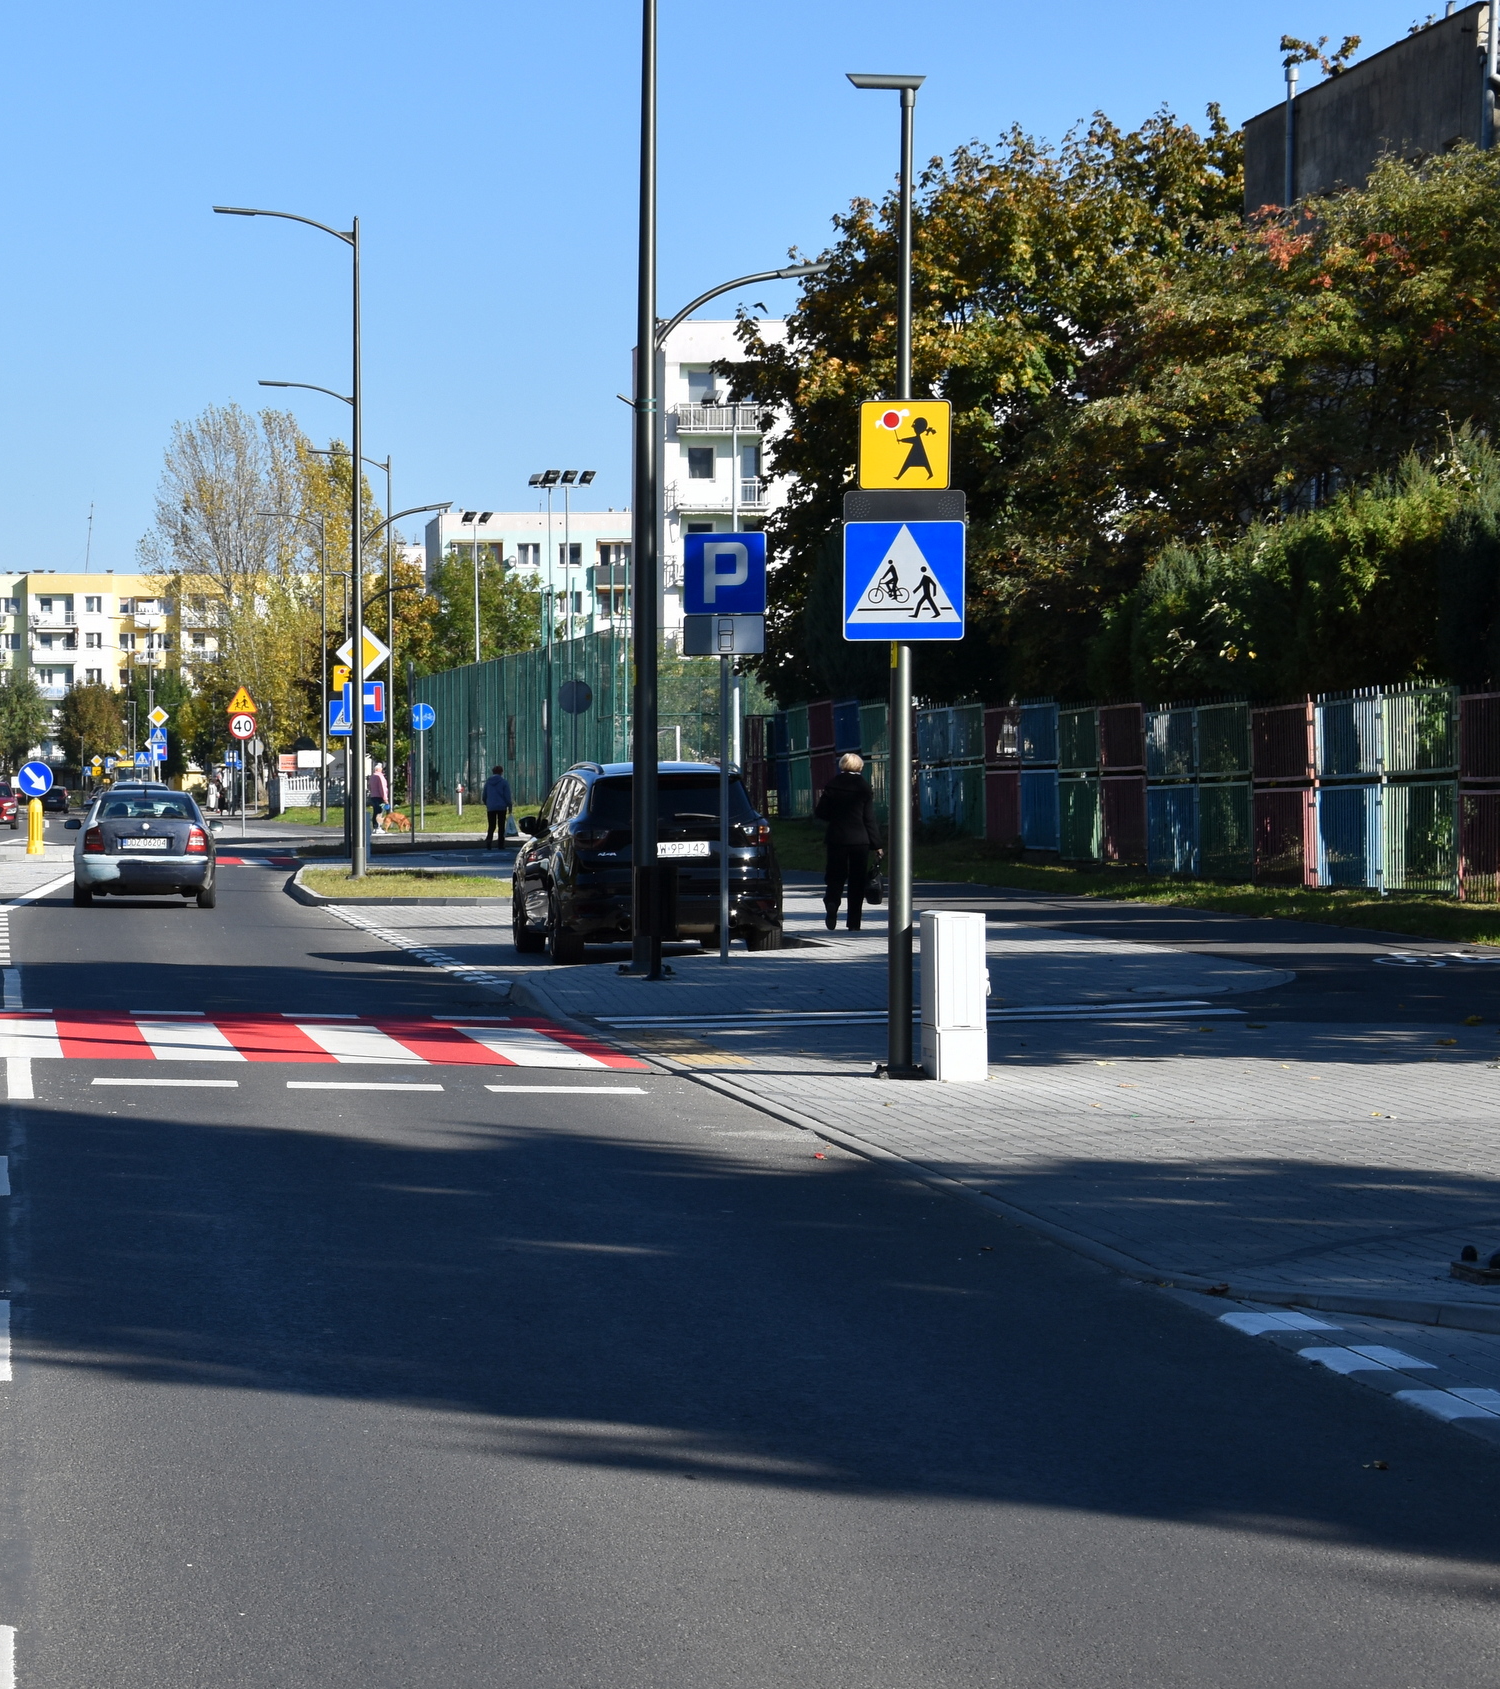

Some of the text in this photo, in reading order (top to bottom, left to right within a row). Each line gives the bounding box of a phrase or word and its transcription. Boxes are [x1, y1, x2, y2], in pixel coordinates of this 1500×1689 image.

[703, 541, 749, 604] P
[233, 719, 252, 732] 40
[659, 842, 706, 854] W 9PJ42
